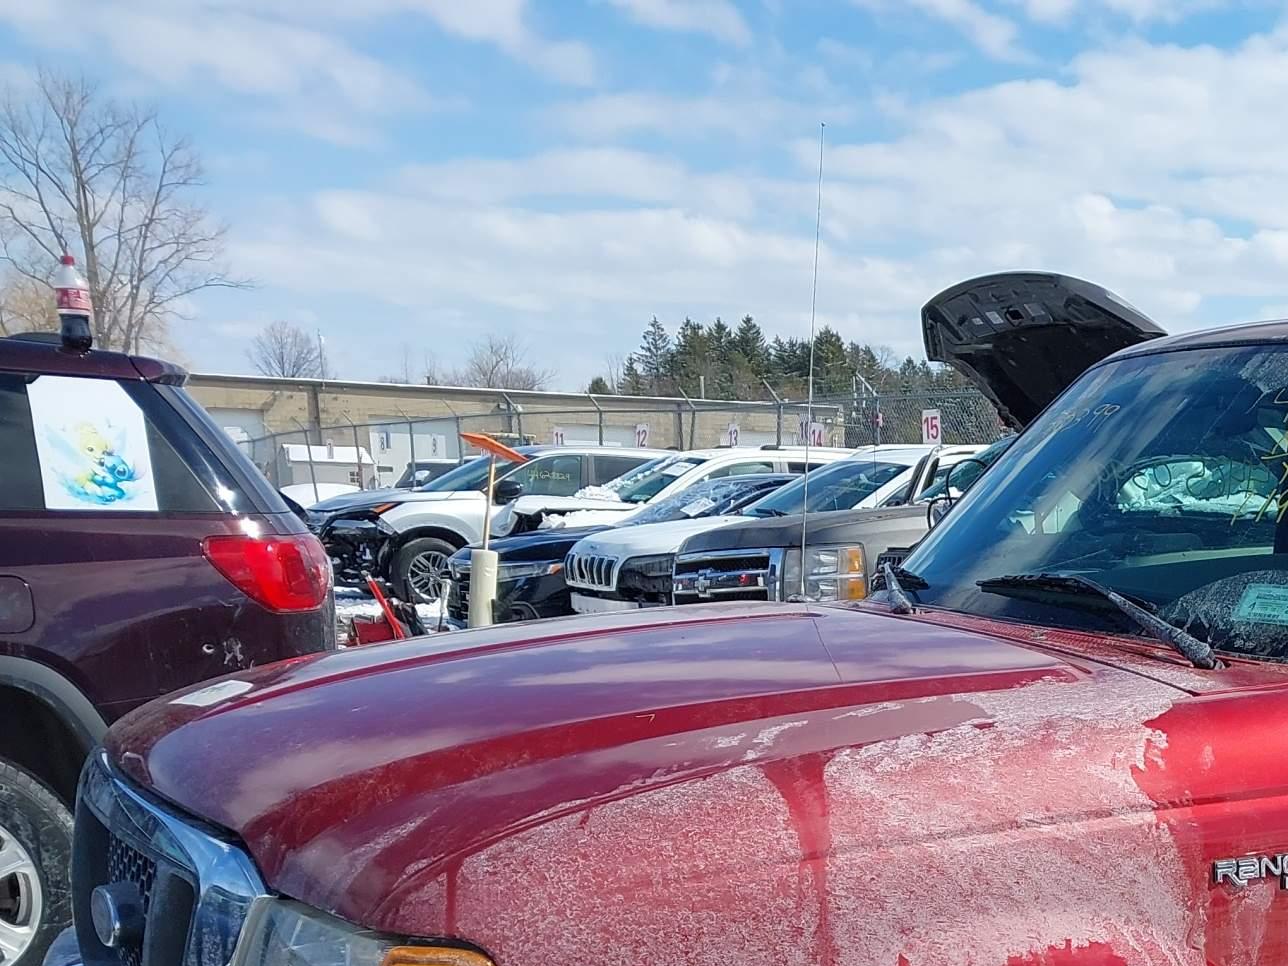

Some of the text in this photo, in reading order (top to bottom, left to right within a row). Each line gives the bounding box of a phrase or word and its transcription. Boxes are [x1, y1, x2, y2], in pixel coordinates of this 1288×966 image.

[924, 416, 939, 440] 15
[554, 431, 564, 447] 11
[636, 429, 648, 448] 12
[729, 429, 738, 447] 13
[811, 429, 823, 446] 14
